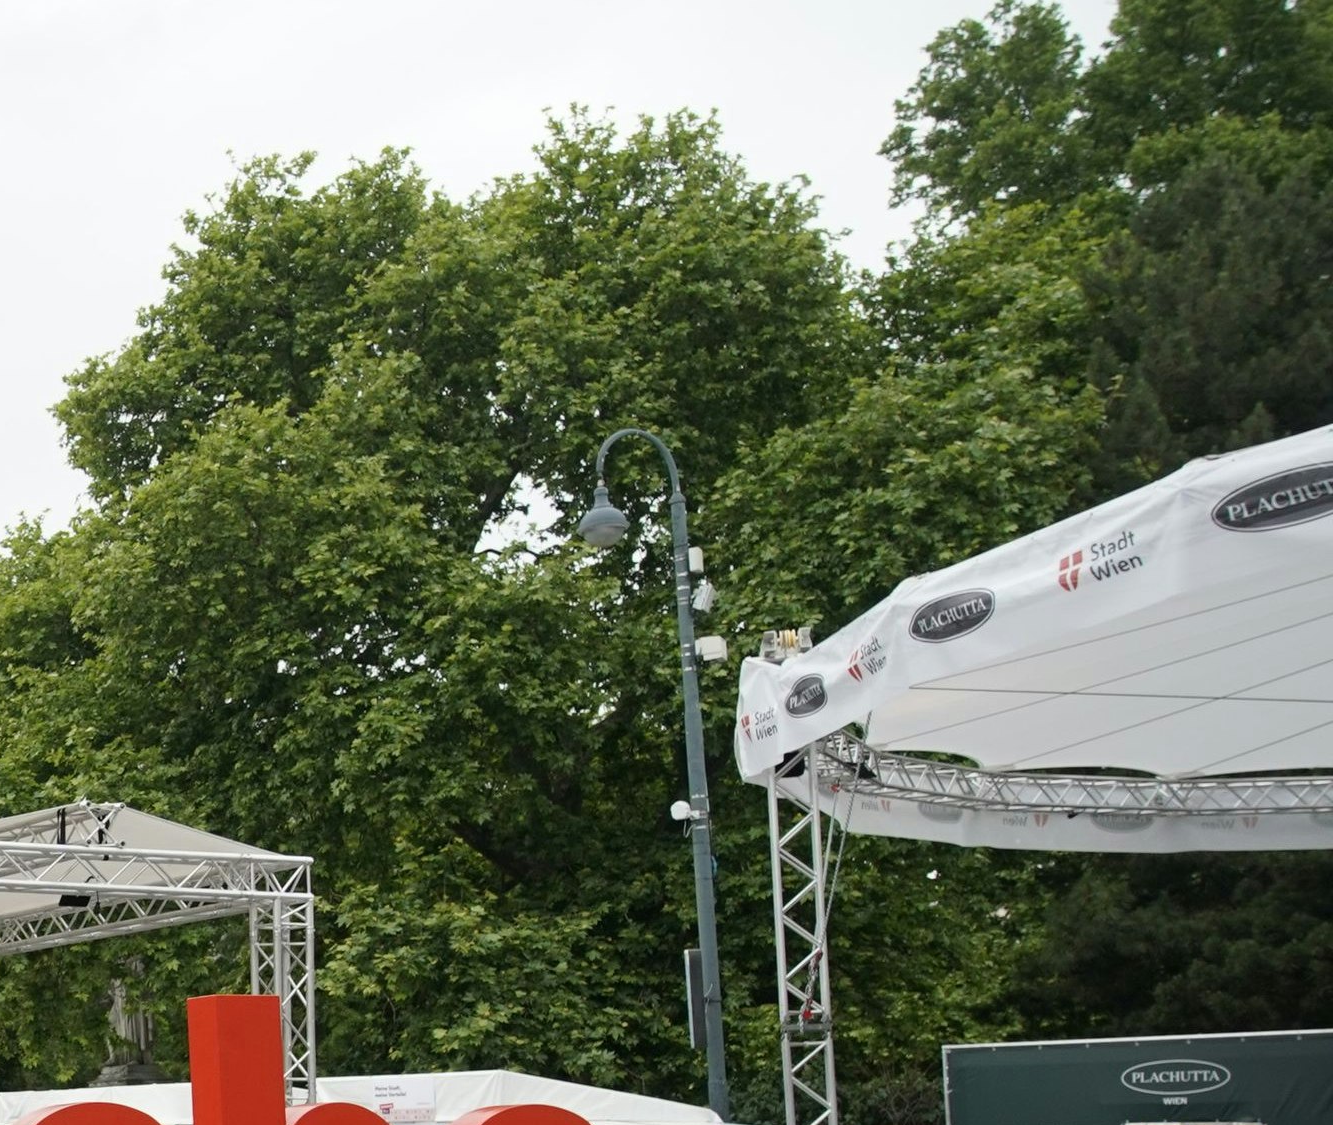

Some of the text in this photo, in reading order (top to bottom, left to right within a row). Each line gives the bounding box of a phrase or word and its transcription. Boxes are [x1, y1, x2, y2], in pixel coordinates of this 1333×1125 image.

[1090, 530, 1135, 562] Stadt
[1090, 554, 1143, 582] Wien
[917, 598, 987, 633] PLACHUTTA
[860, 635, 882, 660] Stadt
[863, 656, 887, 675] Wien
[754, 706, 775, 724] Stadt
[755, 723, 778, 740] Wien
[1132, 1070, 1220, 1084] PLACHUTTA
[1162, 1097, 1188, 1105] WIEN
